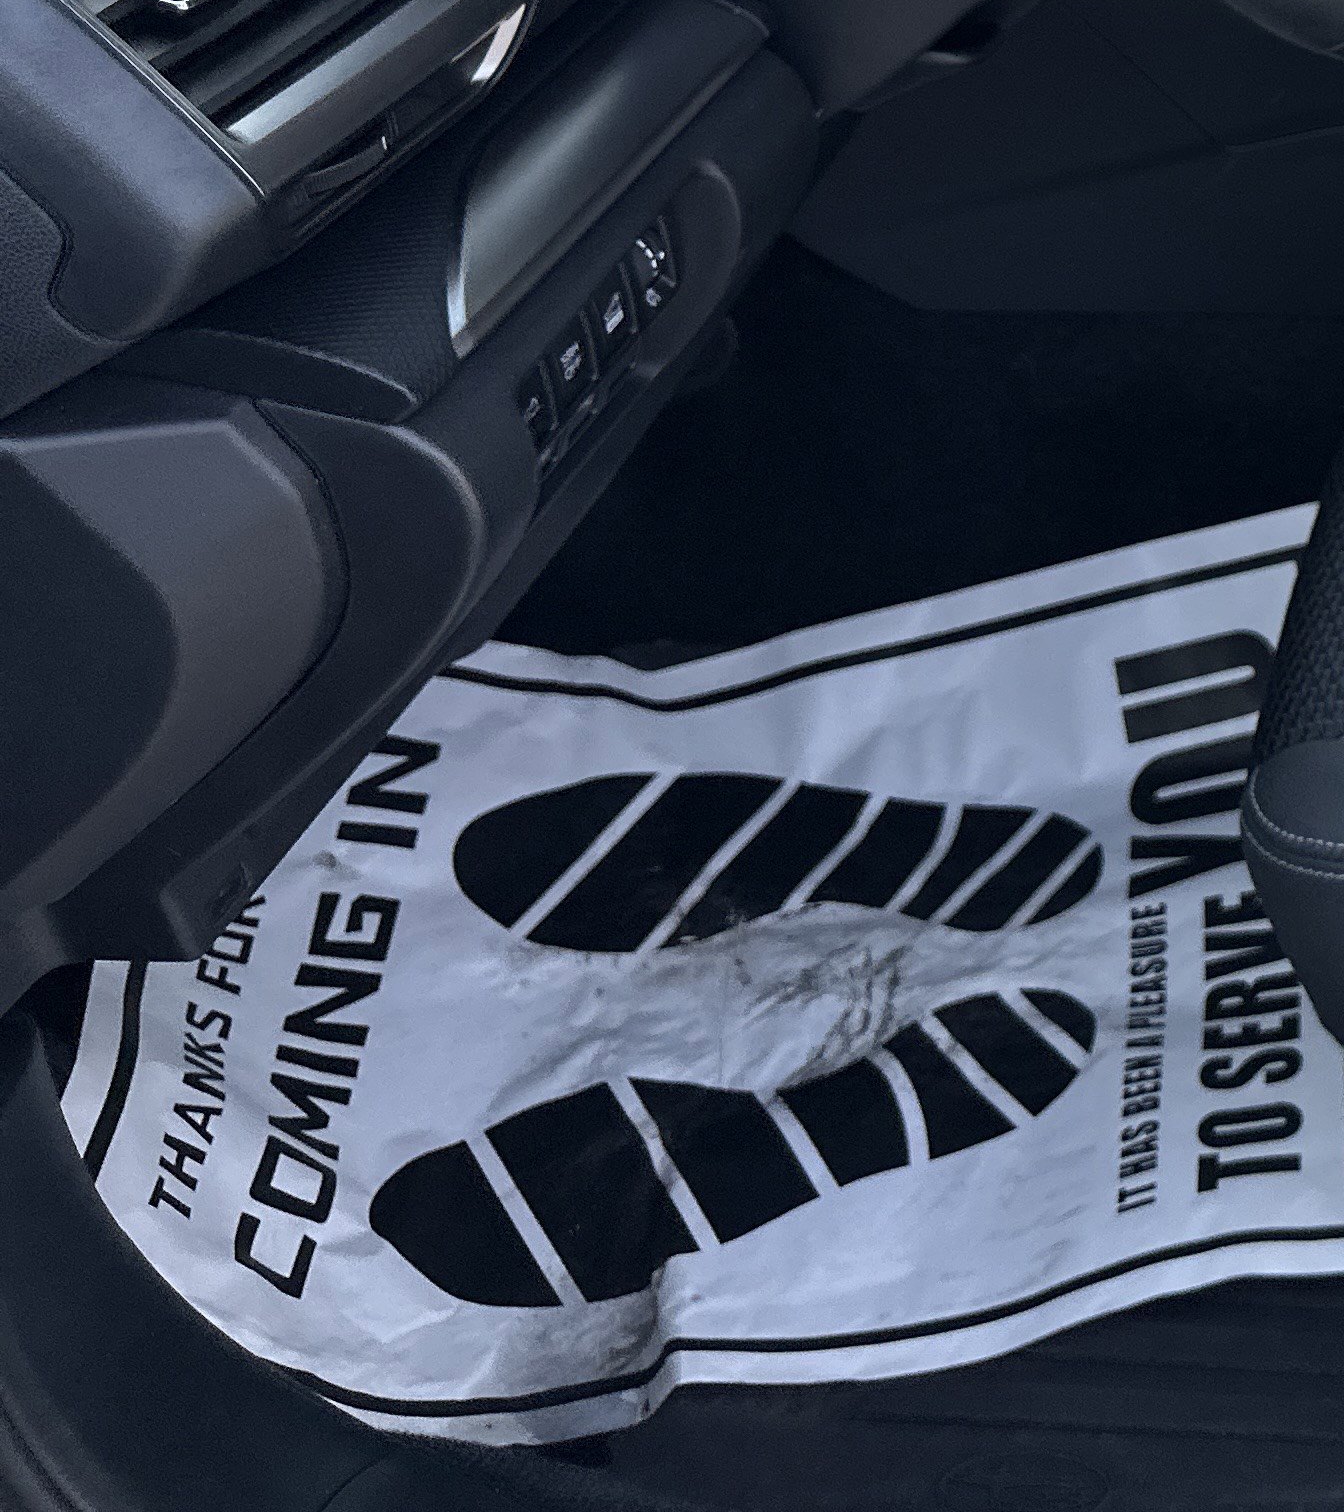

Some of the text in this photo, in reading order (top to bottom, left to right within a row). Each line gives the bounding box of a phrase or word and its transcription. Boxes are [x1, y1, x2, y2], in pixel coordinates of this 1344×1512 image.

[148, 1000, 233, 1219] THANKS
[234, 734, 442, 1299] COMING IN
[1114, 628, 1304, 1192] TO SERVE YOU
[1117, 901, 1168, 1213] IT HAS BEEN A PLEASURE
